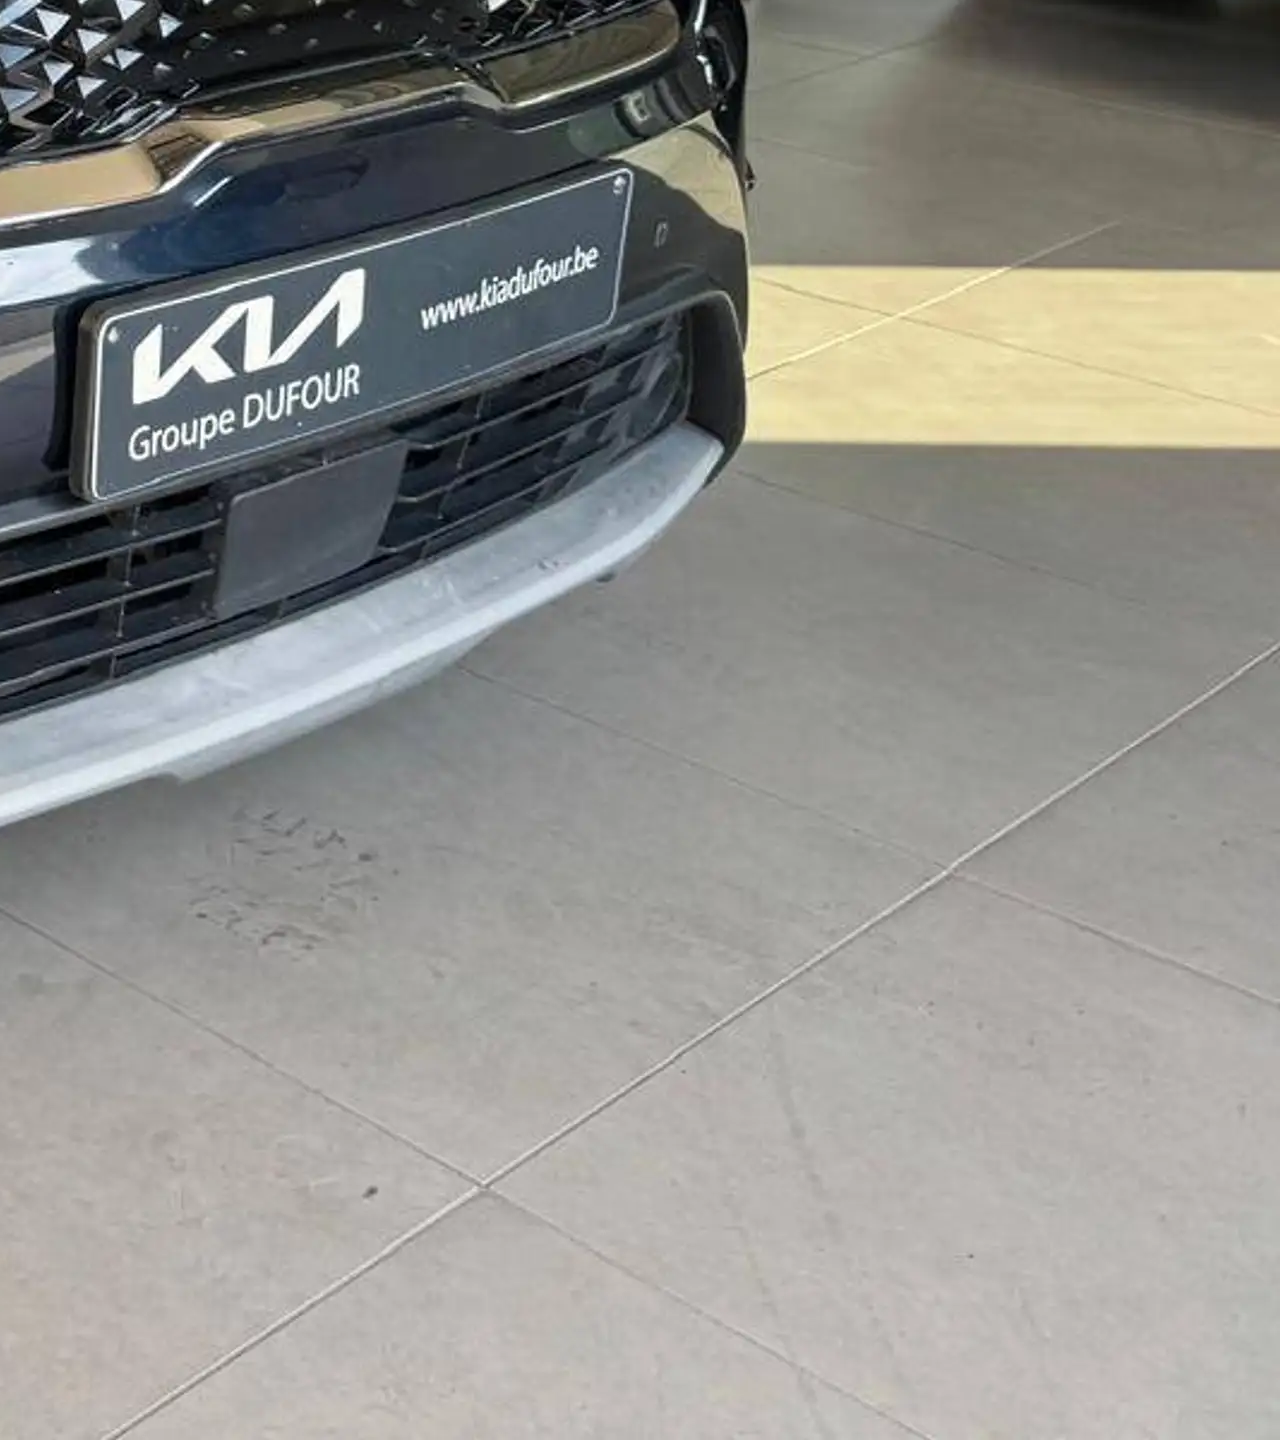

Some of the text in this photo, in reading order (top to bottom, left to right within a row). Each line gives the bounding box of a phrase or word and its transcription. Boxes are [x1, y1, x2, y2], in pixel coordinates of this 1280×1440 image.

[132, 268, 366, 406] KIA
[420, 243, 599, 332] www.kiadufour.be
[128, 363, 361, 463] Groupe DUFOUR
